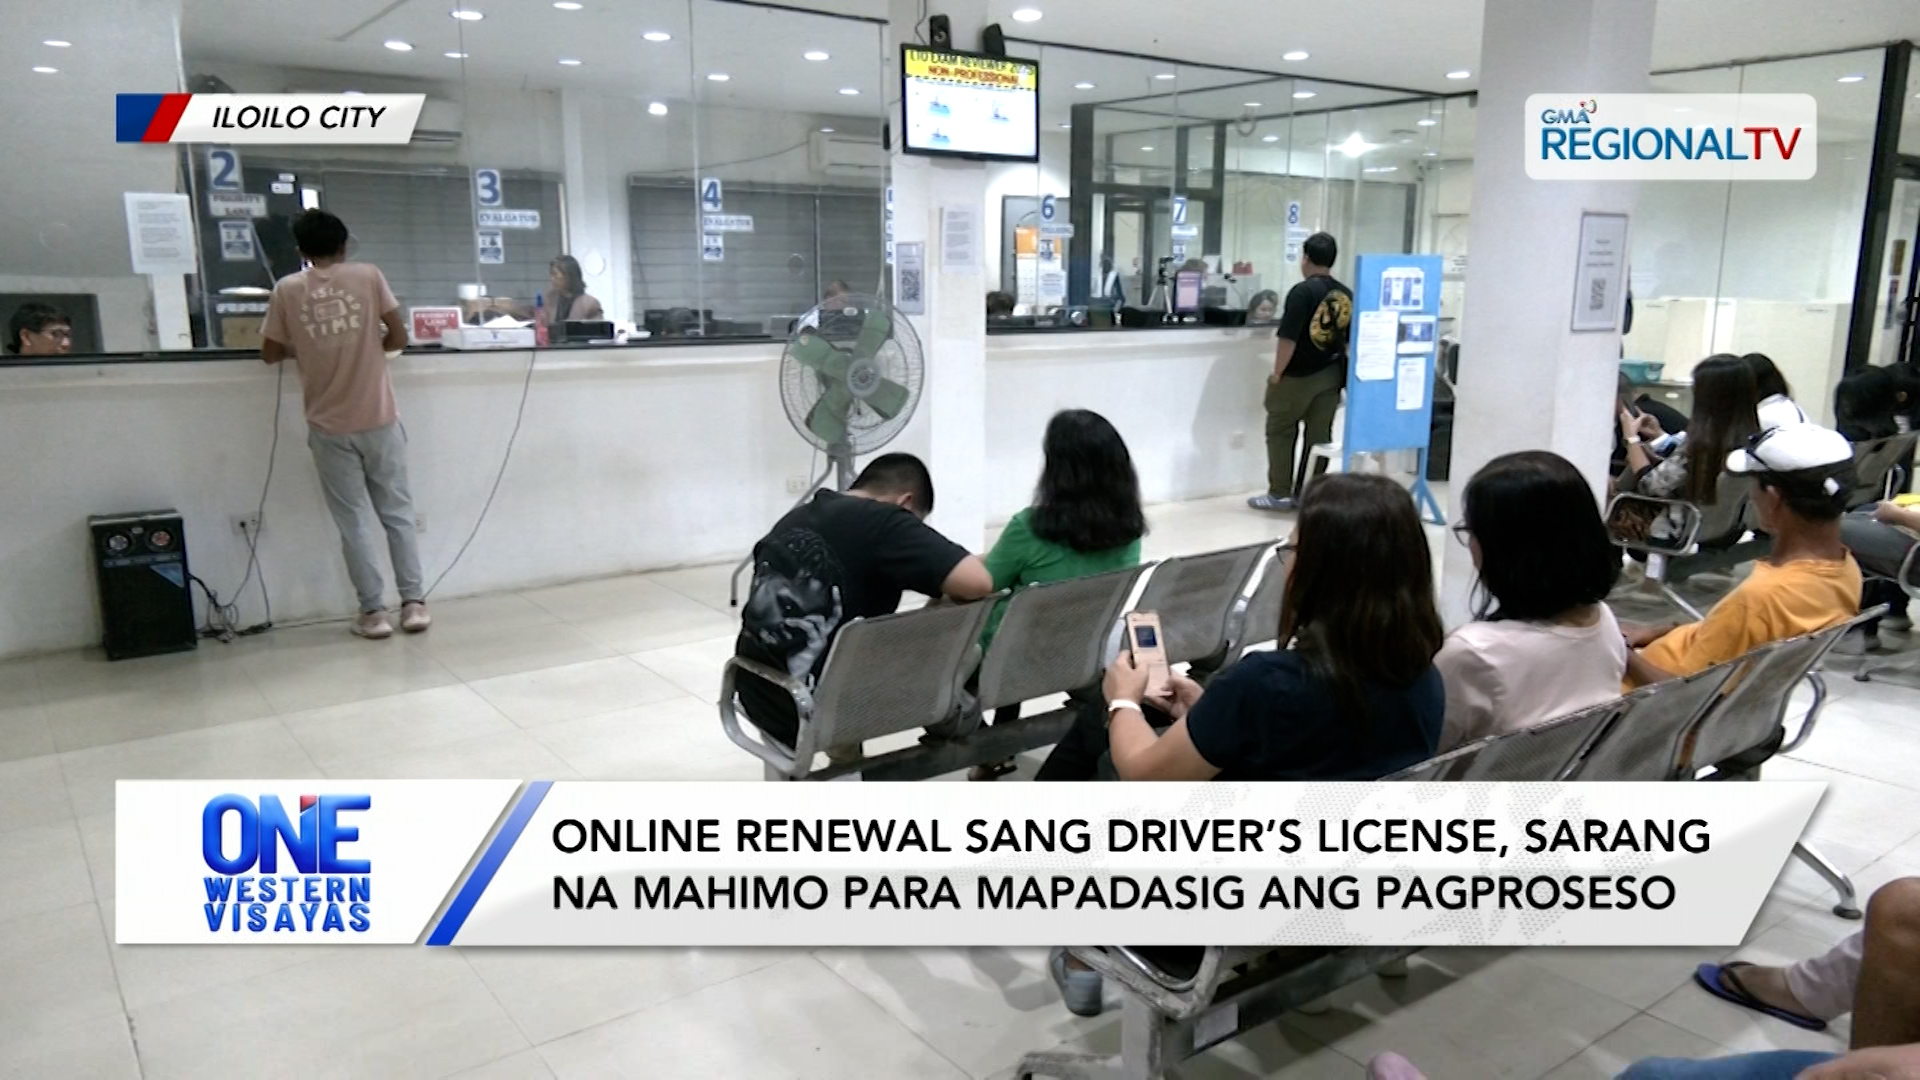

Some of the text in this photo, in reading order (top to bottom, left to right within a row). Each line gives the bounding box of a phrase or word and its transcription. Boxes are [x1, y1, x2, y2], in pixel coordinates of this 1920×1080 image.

[211, 150, 239, 187] 2
[479, 171, 500, 204] 3
[703, 181, 721, 208] 4
[1042, 194, 1055, 220] 6
[1174, 199, 1186, 222] 7
[1288, 203, 1299, 224] 8
[304, 315, 361, 338] TIME
